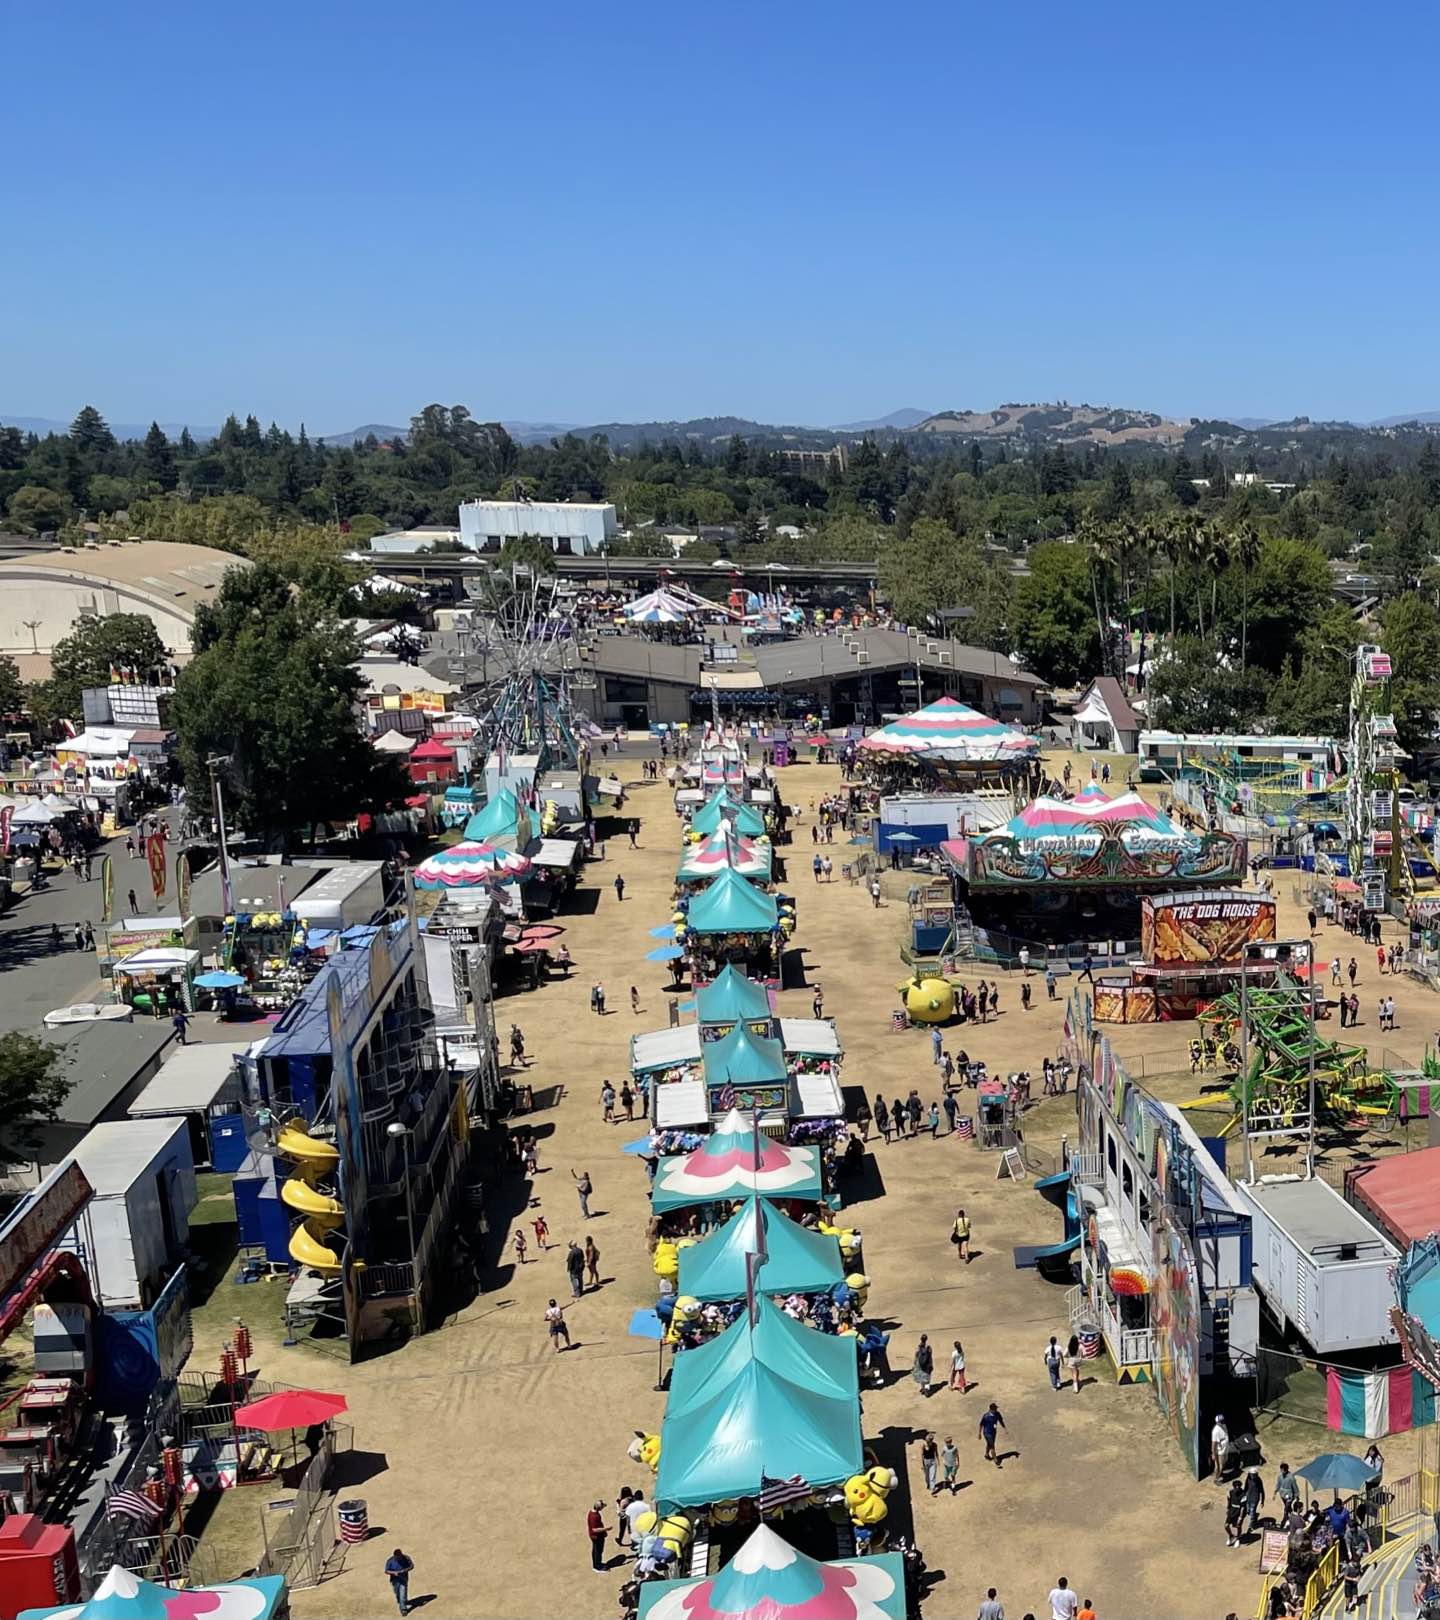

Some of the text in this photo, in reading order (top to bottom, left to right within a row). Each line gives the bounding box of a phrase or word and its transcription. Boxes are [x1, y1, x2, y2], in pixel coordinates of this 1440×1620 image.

[1023, 835, 1200, 852] HAWAIIAN EXPRESS
[1172, 903, 1260, 919] THE DOG HOUSE
[719, 1024, 766, 1037] WIER
